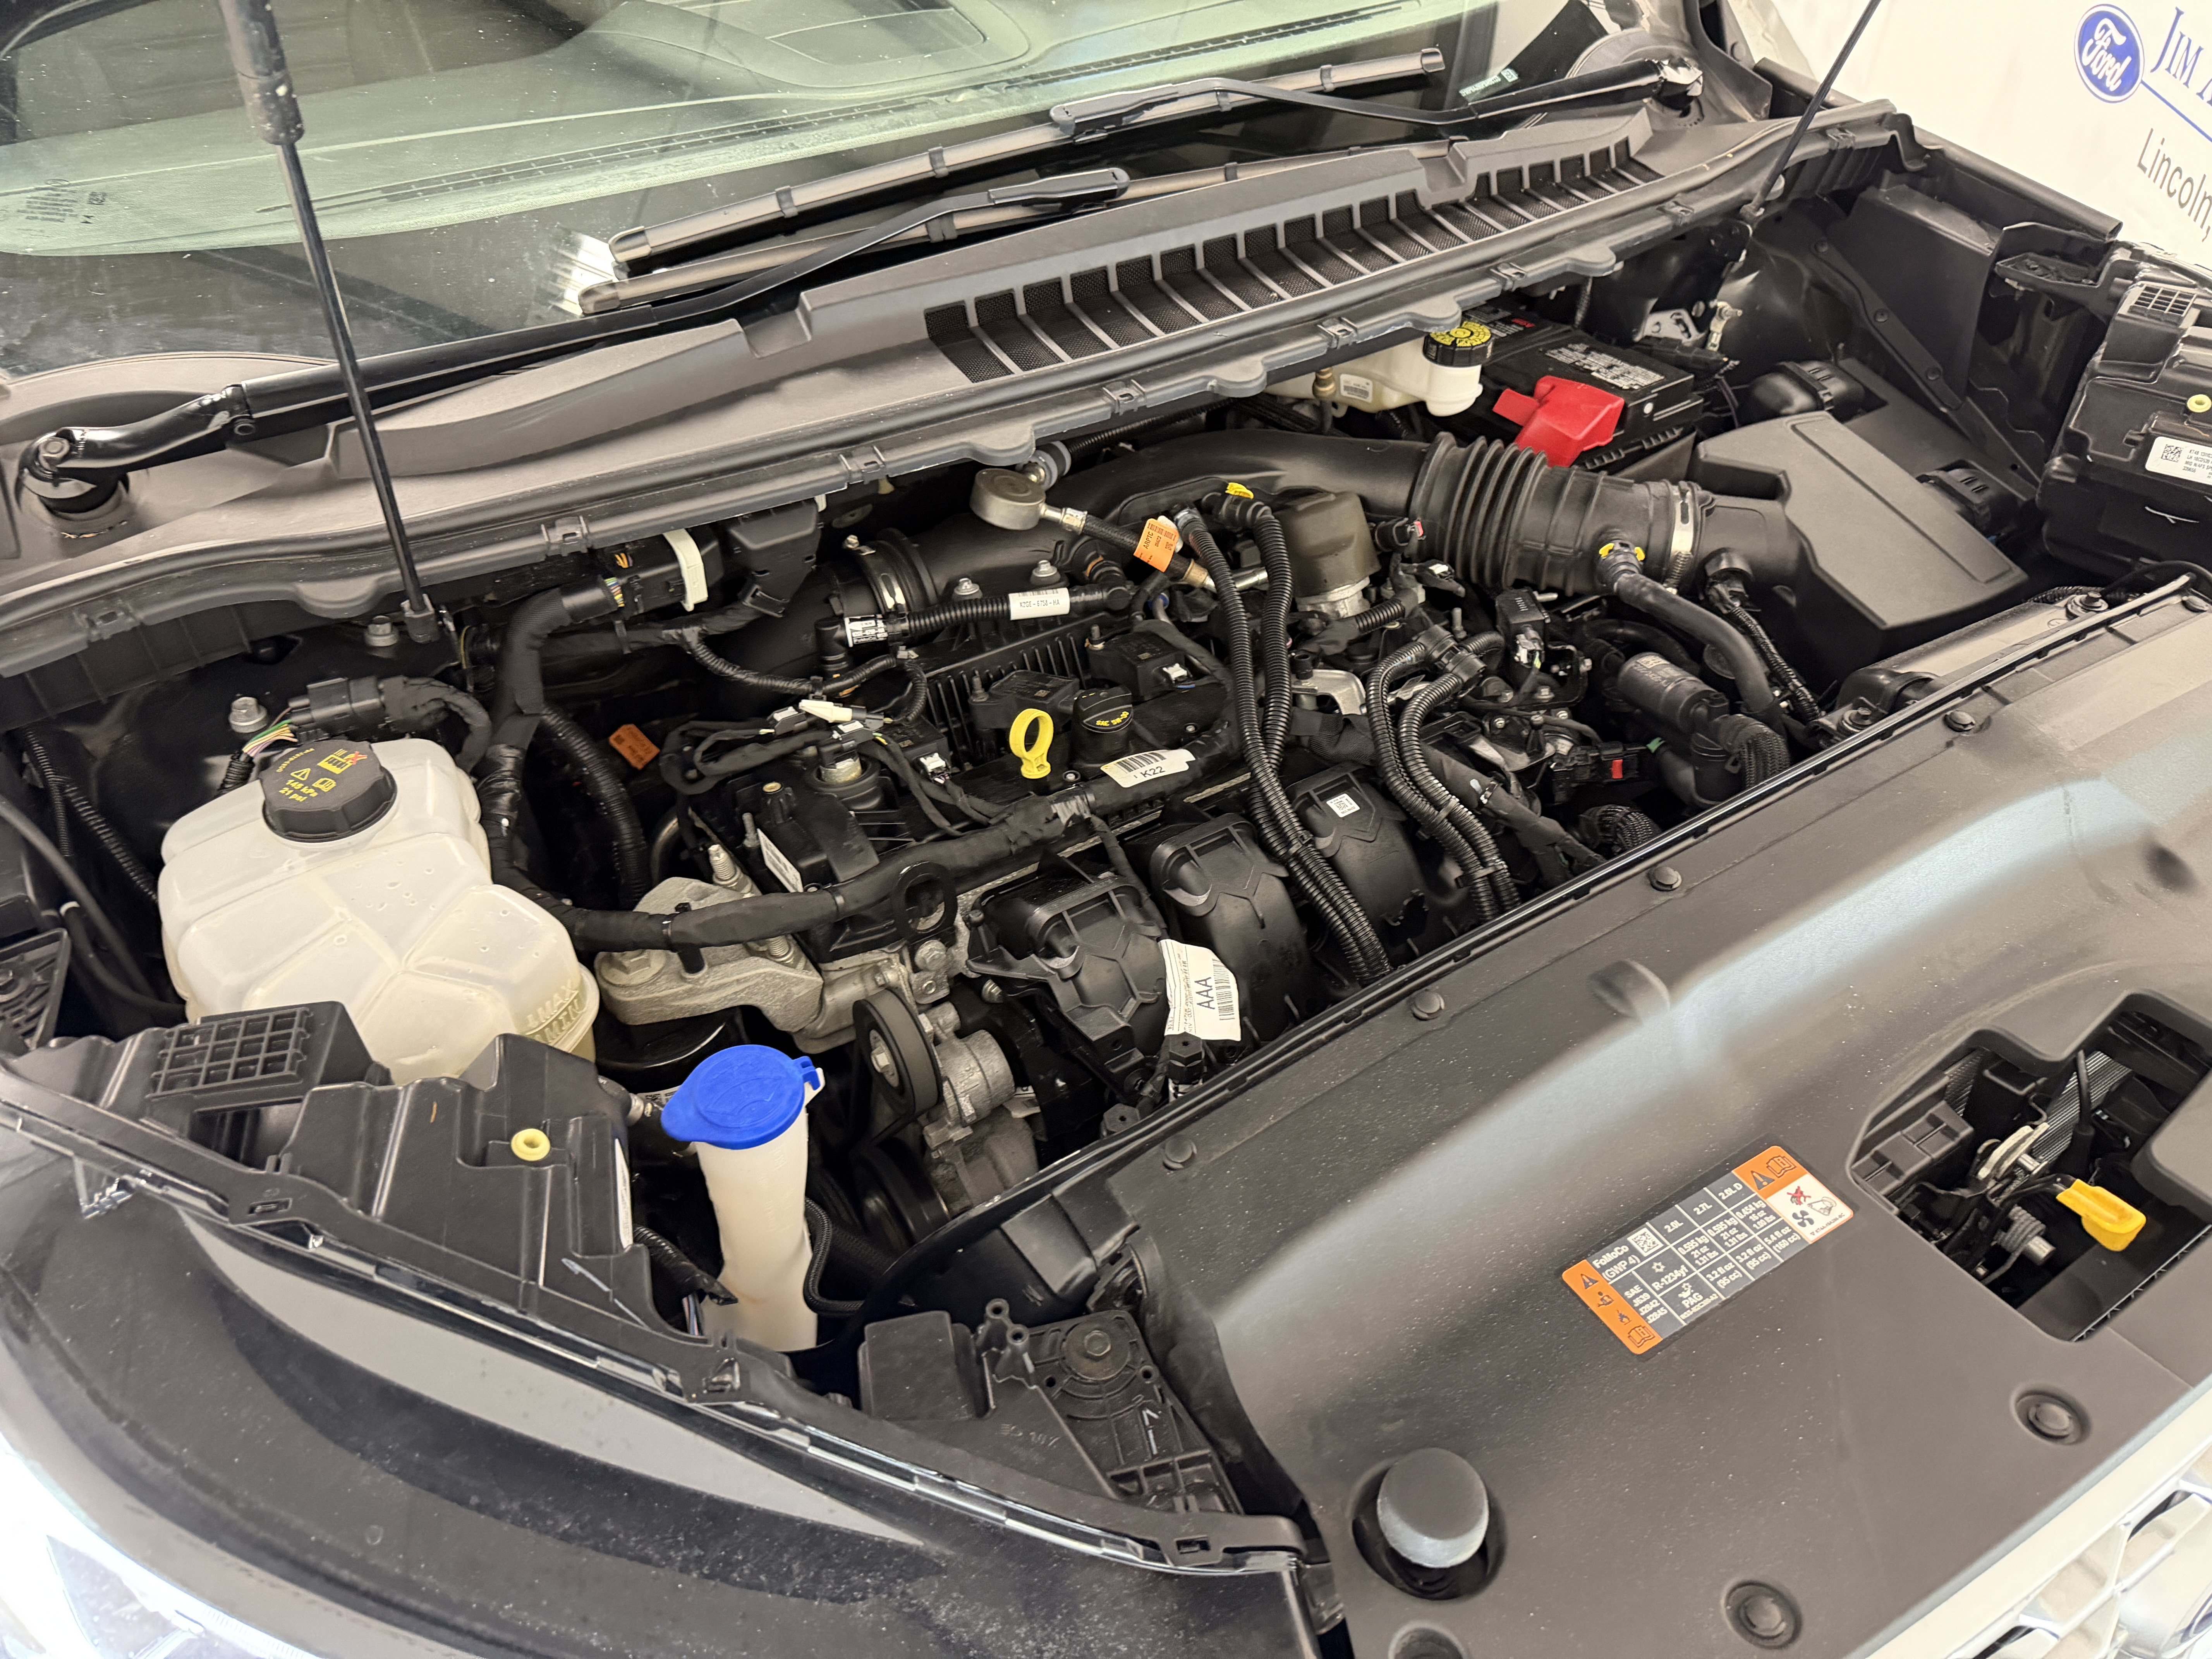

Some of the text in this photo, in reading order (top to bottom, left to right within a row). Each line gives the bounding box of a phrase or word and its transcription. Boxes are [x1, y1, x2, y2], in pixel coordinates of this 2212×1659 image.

[2081, 17, 2132, 91] Ford
[1143, 531, 1153, 549] ARPTC
[1140, 765, 1165, 779] K22
[279, 787, 307, 802] 21 psi
[286, 780, 318, 797] 145 kPa
[537, 979, 571, 1023] MAX
[1194, 977, 1215, 1010] AAA
[1718, 1182, 1743, 1200] 2.0L D
[1693, 1202, 1712, 1215] 2.7L
[1664, 1220, 1684, 1233] 2.0L
[1724, 1217, 1738, 1226] kg
[1695, 1235, 1710, 1244] kg
[1592, 1245, 1629, 1269] FoMoCo
[1602, 1255, 1641, 1281] (GWP 4)
[1652, 1265, 1688, 1291] R-1234yf
[1624, 1285, 1643, 1298] SAE
[1681, 1292, 1703, 1308] PAG
